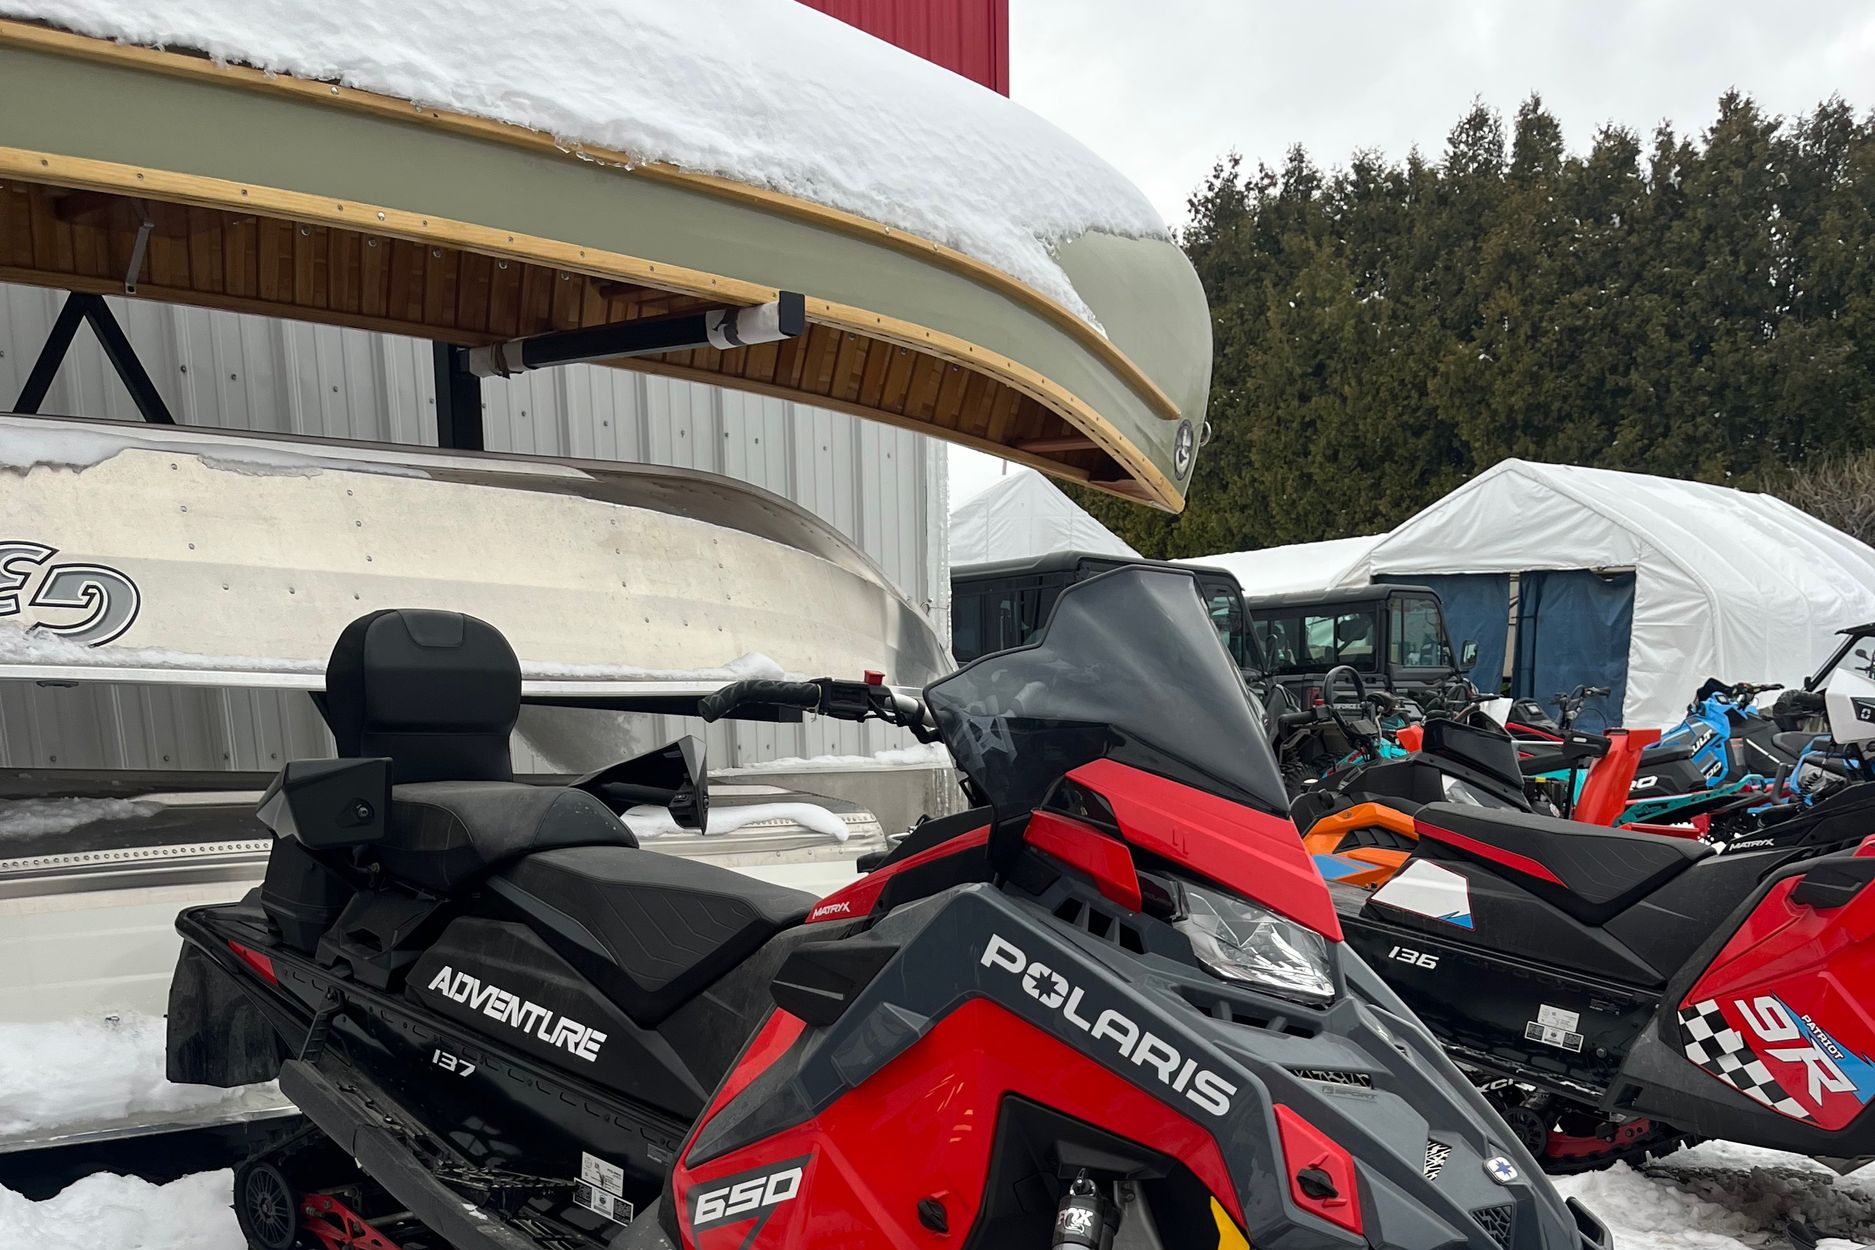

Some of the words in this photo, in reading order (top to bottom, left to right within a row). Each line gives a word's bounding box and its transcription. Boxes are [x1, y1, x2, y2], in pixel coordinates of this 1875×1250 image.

[1729, 838, 1774, 851] MATRYX
[812, 901, 850, 920] MATRYX
[1388, 946, 1440, 970] 136
[428, 965, 608, 1063] ADVENTURE
[980, 933, 1238, 1117] POLARIS
[1800, 1013, 1845, 1060] PATRIOT
[432, 1048, 476, 1078] 137
[694, 1167, 803, 1226] 650
[1058, 1207, 1094, 1233] FOX
